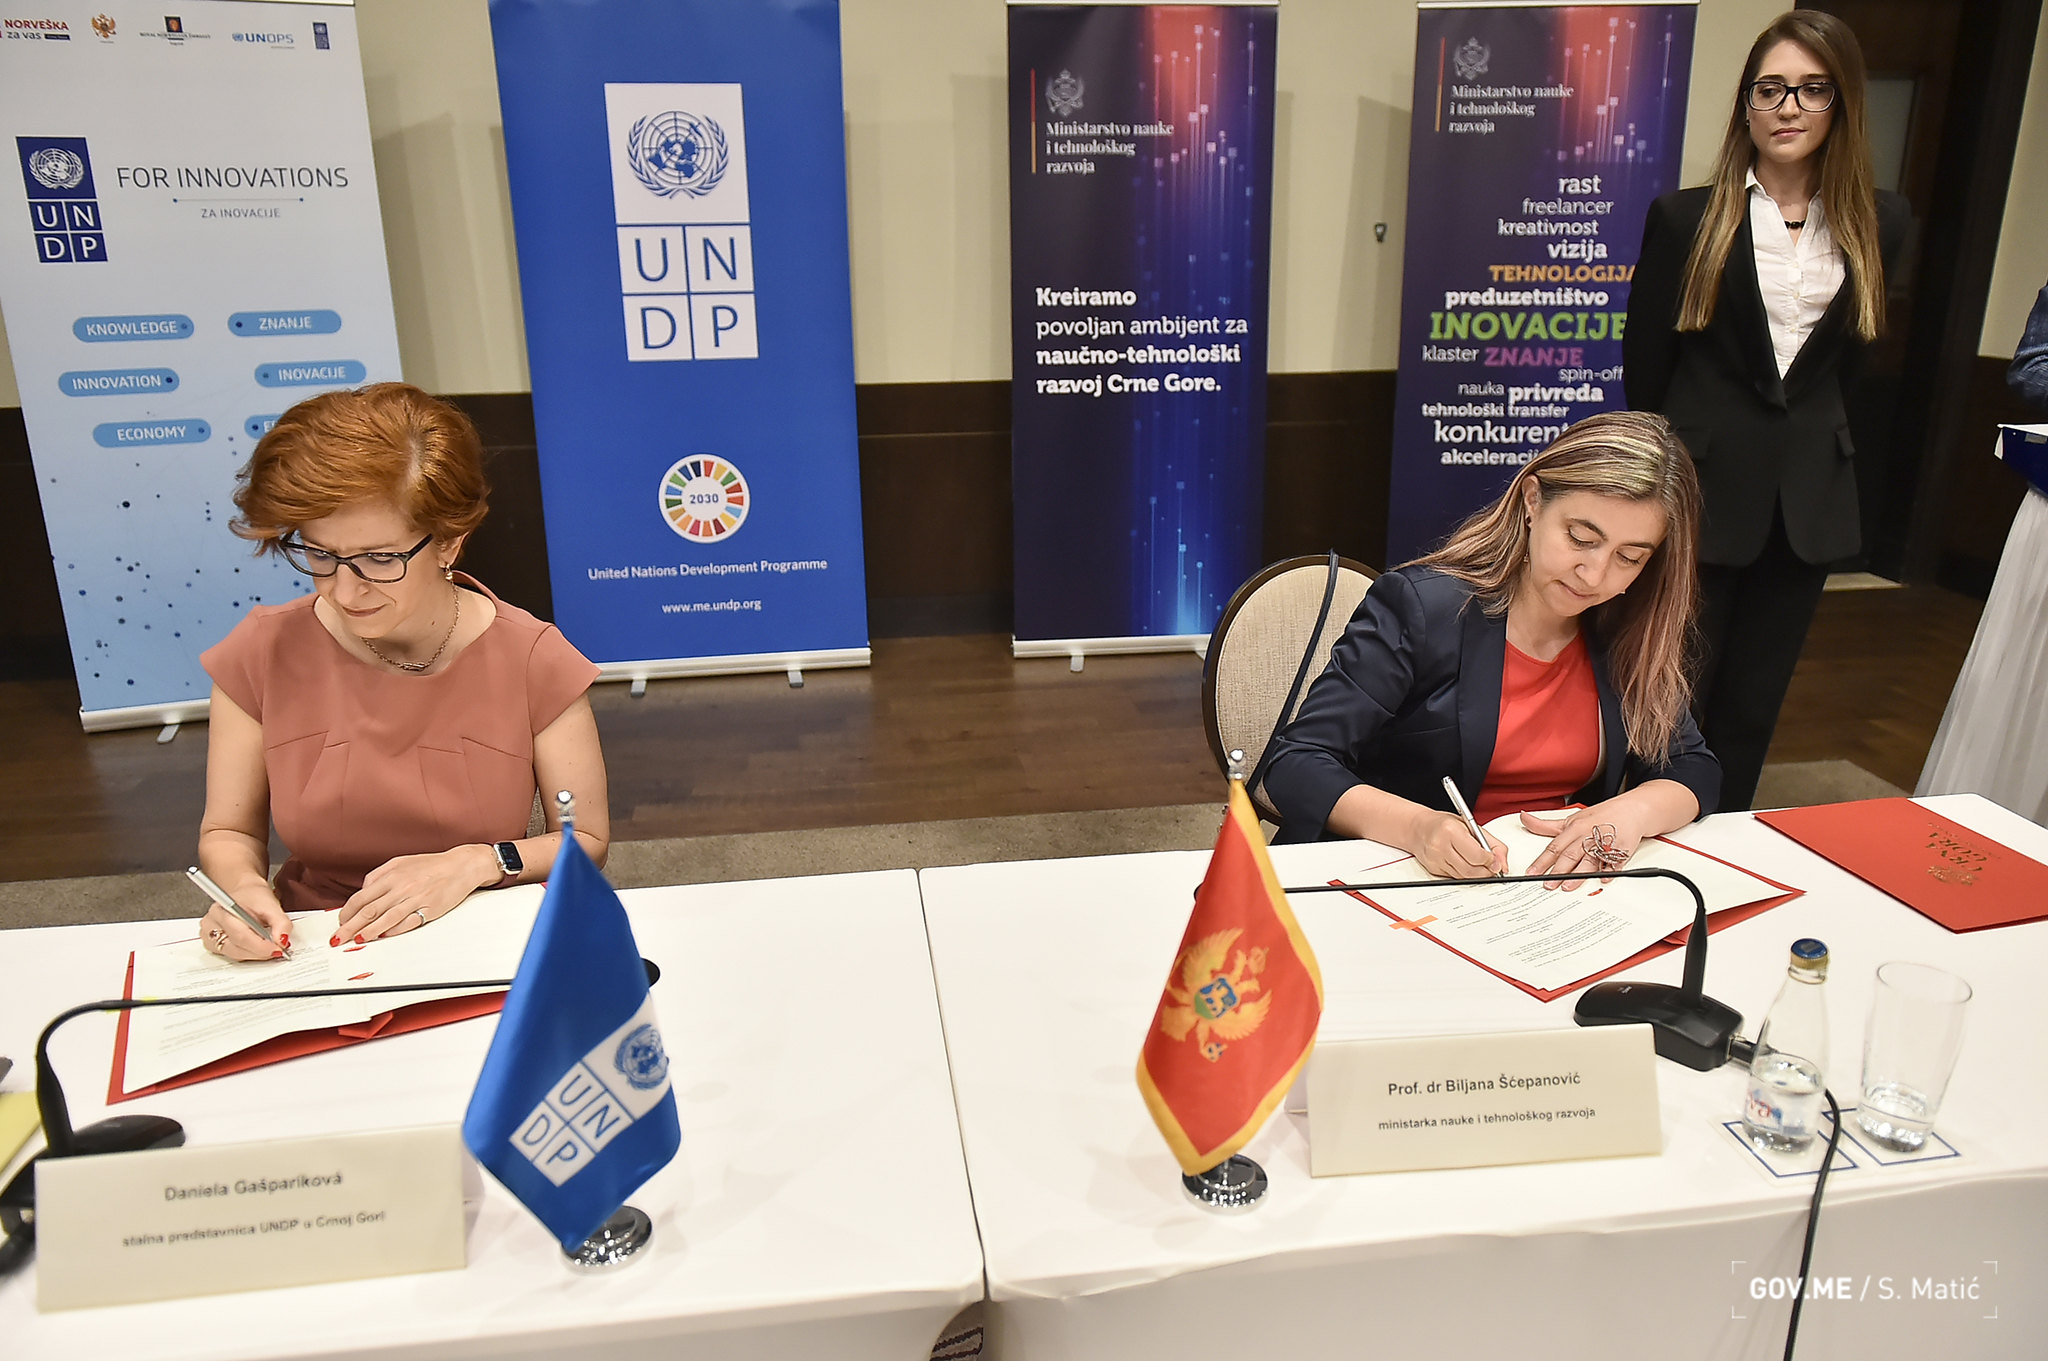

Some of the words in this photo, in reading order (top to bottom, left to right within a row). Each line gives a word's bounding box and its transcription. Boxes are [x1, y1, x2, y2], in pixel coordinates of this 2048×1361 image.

[4, 19, 70, 30] NORVEŠKA
[7, 31, 21, 39] za
[23, 32, 42, 40] vas
[245, 33, 295, 44] UNOPS
[1451, 83, 1532, 99] Ministarstvo
[1534, 82, 1574, 98] nauke
[1450, 102, 1455, 116] i
[1457, 101, 1536, 119] tehnološkog
[1046, 120, 1131, 136] Ministarstvo
[1133, 120, 1174, 136] nauke
[1448, 118, 1495, 136] razvoja
[1046, 140, 1051, 155] i
[1053, 139, 1136, 157] tehnološkog
[1046, 158, 1095, 176] razvoja
[117, 167, 170, 189] FOR
[177, 166, 349, 188] INNOVATIONS
[1558, 174, 1602, 195] rast
[36, 203, 96, 228] UN
[201, 208, 217, 219] ZA
[220, 207, 281, 219] INOVACIJE
[1522, 197, 1615, 216] freelancer
[1497, 218, 1600, 236] kreativnost
[43, 236, 97, 259] DP
[1547, 238, 1608, 263] vizija
[635, 237, 737, 282] UN
[1036, 286, 1137, 306] Kreiramo
[1445, 286, 1610, 310] preduzetništvo
[86, 319, 178, 337] KNOWLEDGE
[259, 315, 313, 330] ZNANJE
[640, 304, 738, 349] DP
[1036, 316, 1125, 340] povoljan
[1129, 316, 1220, 339] ambijent
[1224, 318, 1248, 334] za
[1429, 311, 1628, 340] INOVACIJE
[1036, 344, 1241, 365] naučno-tehnološki
[1422, 344, 1479, 362] klaster
[1484, 346, 1583, 367] ZNANJE
[72, 373, 162, 391] INNOVATION
[278, 366, 346, 381] INOVACIJE
[1558, 365, 1624, 384] spin-off
[1036, 374, 1102, 398] razvoj
[1107, 373, 1160, 393] Crne
[1163, 372, 1222, 392] Gore.
[1457, 380, 1505, 396] nauka
[1508, 382, 1604, 404] privreda
[1421, 402, 1505, 418] tehnološki
[1507, 402, 1570, 418] transfer
[117, 425, 187, 442] ECONOMY
[689, 493, 719, 505] 2030
[588, 566, 629, 581] United
[631, 563, 677, 578] Nations
[680, 560, 758, 576] Development
[761, 558, 827, 574] Programme
[661, 599, 762, 614] www.me.undp.org
[1388, 1081, 1422, 1096] Prof.
[1426, 1081, 1441, 1093] dr
[1445, 1078, 1495, 1094] Biljana
[1378, 1118, 1438, 1131] ministarka
[1440, 1114, 1475, 1127] nauke
[1483, 1110, 1553, 1123] tehnološkog
[1556, 1107, 1596, 1119] razvoja
[164, 1183, 229, 1201] Daniela
[122, 1233, 164, 1247] stalna
[168, 1225, 256, 1245] predstavnica
[259, 1217, 299, 1233] UNDP
[303, 1220, 312, 1229] u
[315, 1215, 353, 1228] Crnoj
